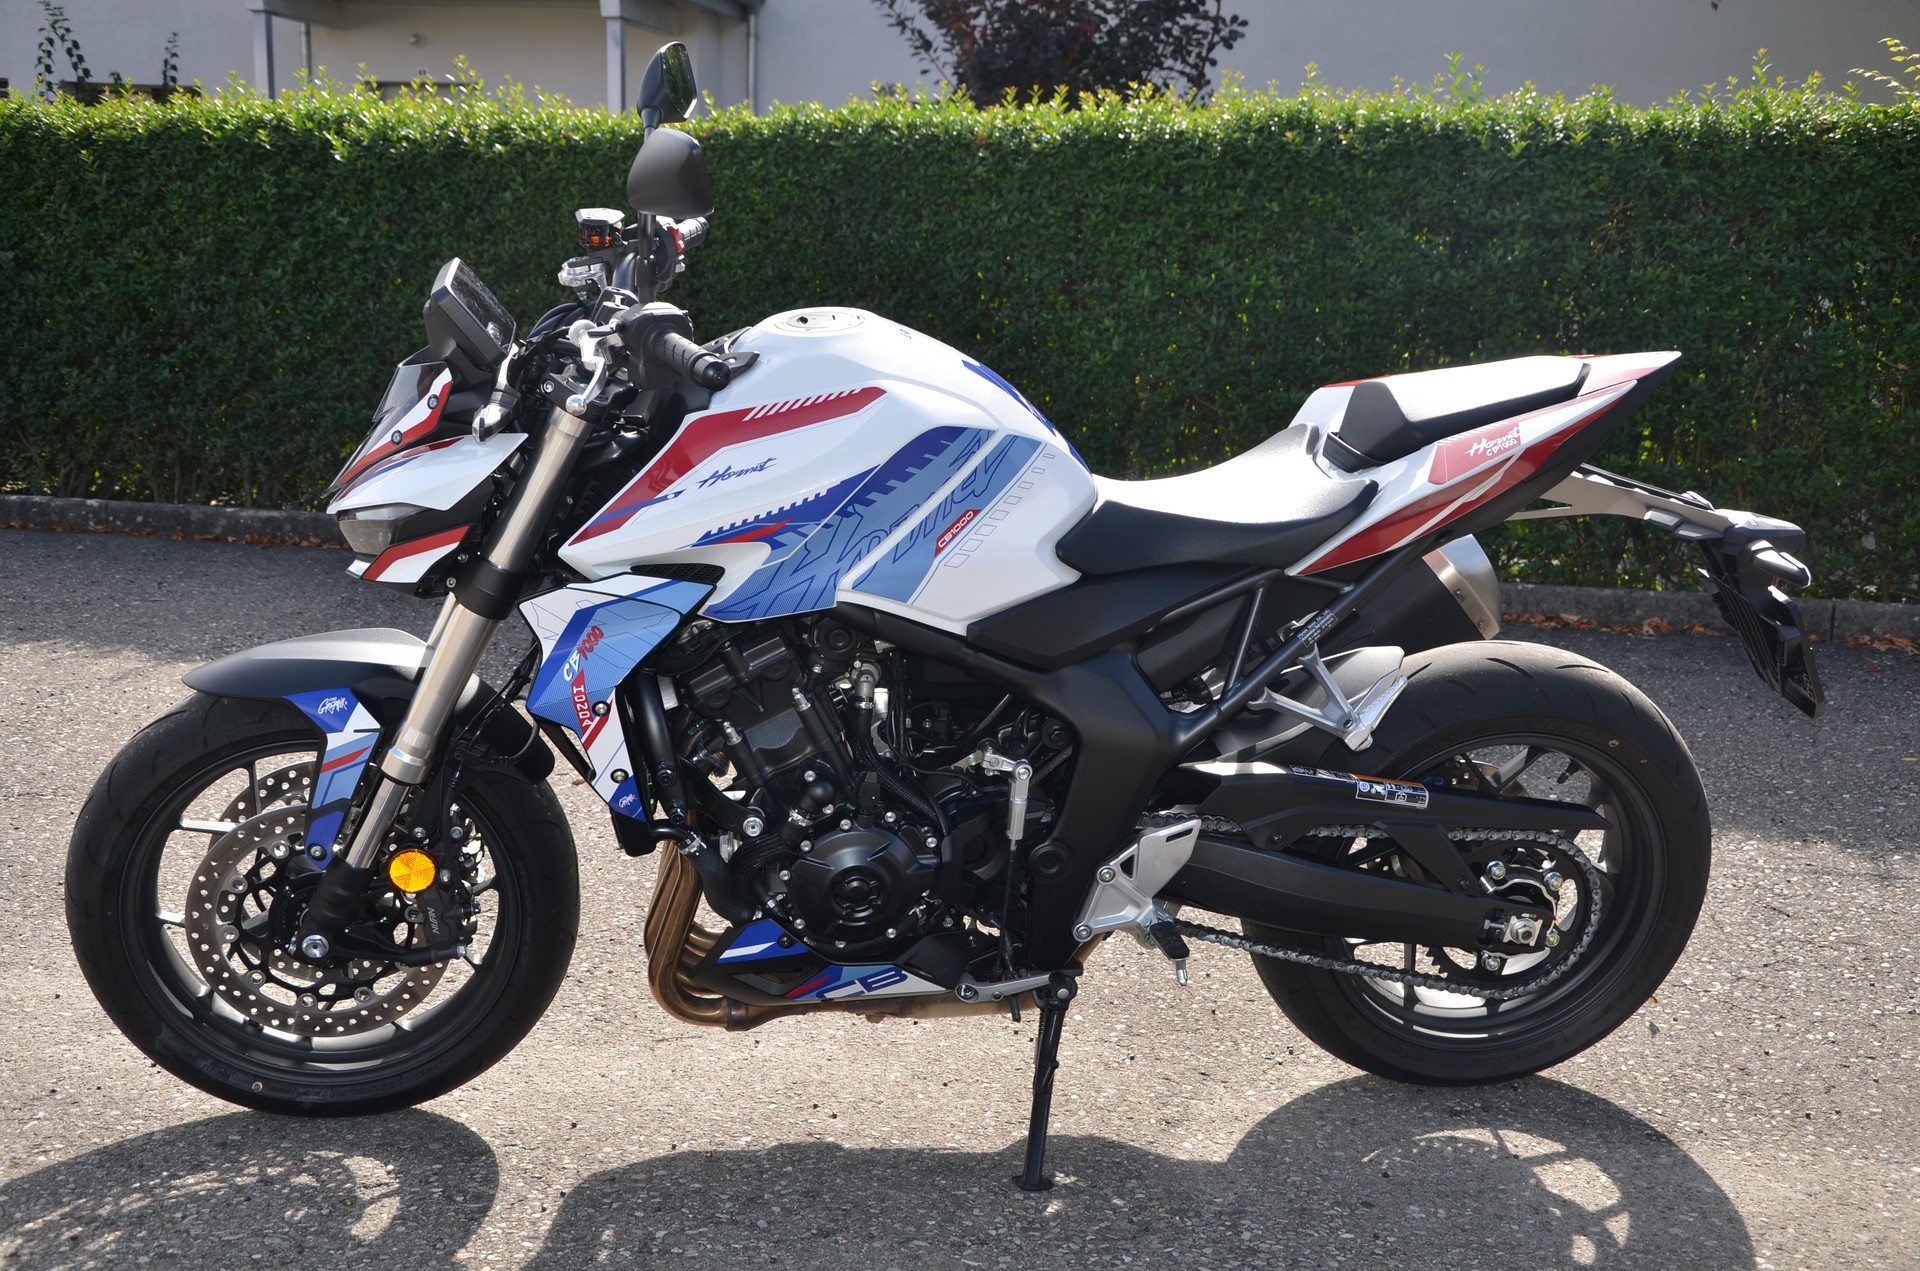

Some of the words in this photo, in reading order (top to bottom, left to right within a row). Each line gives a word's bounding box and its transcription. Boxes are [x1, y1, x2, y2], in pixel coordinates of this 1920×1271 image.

[696, 457, 777, 489] Hornet
[937, 511, 974, 548] CB1000
[573, 685, 593, 727] HONDA
